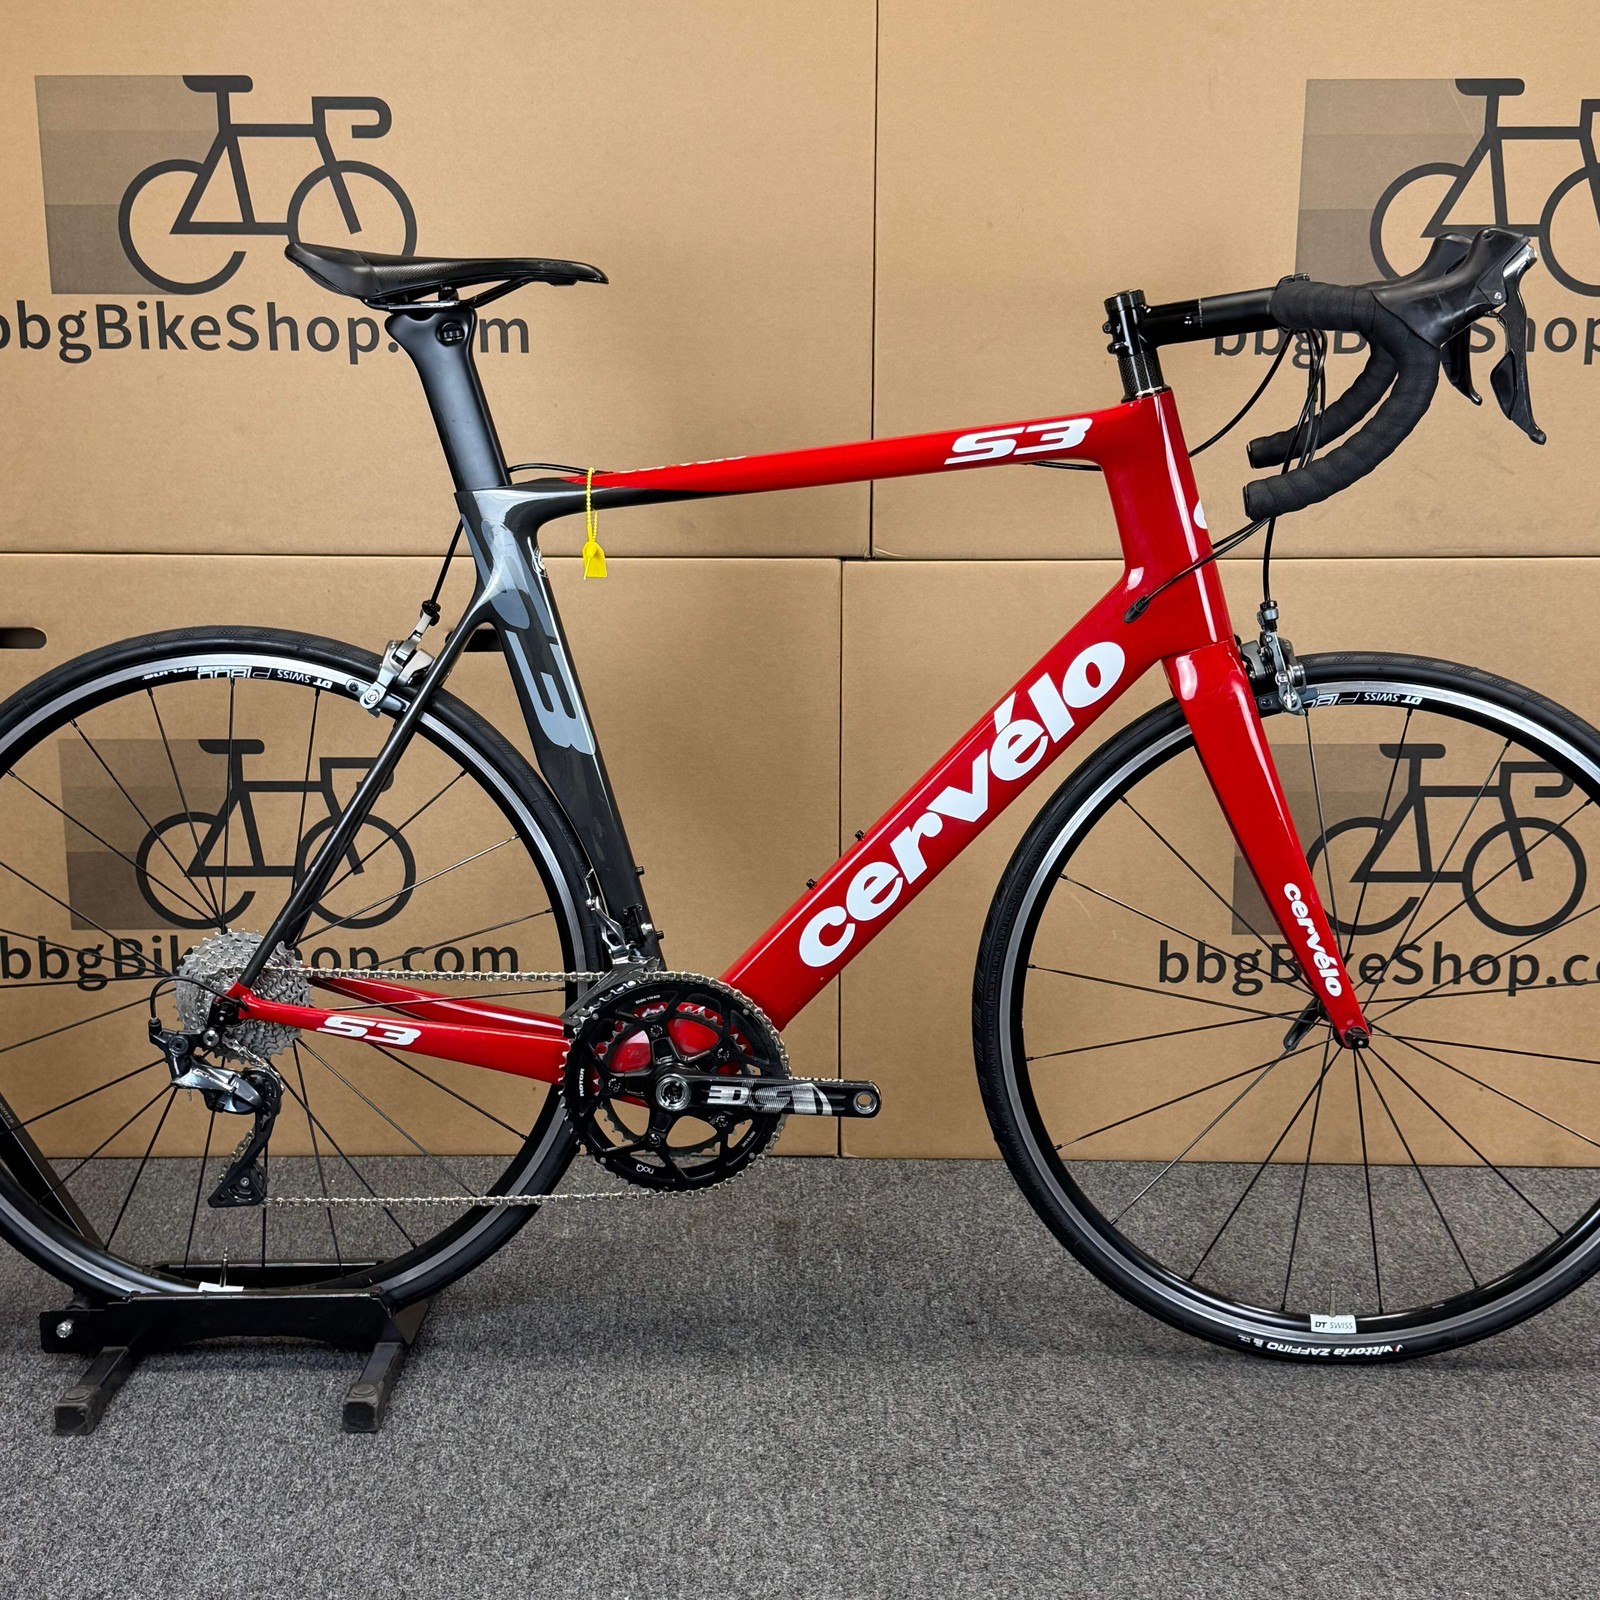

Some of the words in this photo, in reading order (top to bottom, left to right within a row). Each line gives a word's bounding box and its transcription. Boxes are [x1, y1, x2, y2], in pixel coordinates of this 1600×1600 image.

[0, 300, 529, 365] bgBikeShop.m
[944, 418, 1093, 465] S3
[277, 669, 312, 683] SWISS
[313, 680, 333, 689] DT
[1364, 692, 1400, 702] SWISS
[1401, 695, 1423, 706] DT
[799, 641, 1126, 967] cervélo
[1283, 883, 1342, 997] cervélo
[0, 935, 519, 991] bbgBikopcom
[1159, 939, 1600, 997] bbgBeShop.c
[316, 1016, 421, 1046] S3
[578, 1068, 586, 1097] ROTOR
[1266, 1342, 1331, 1357] ZAFFIRO
[1333, 1344, 1394, 1358] vittoria
